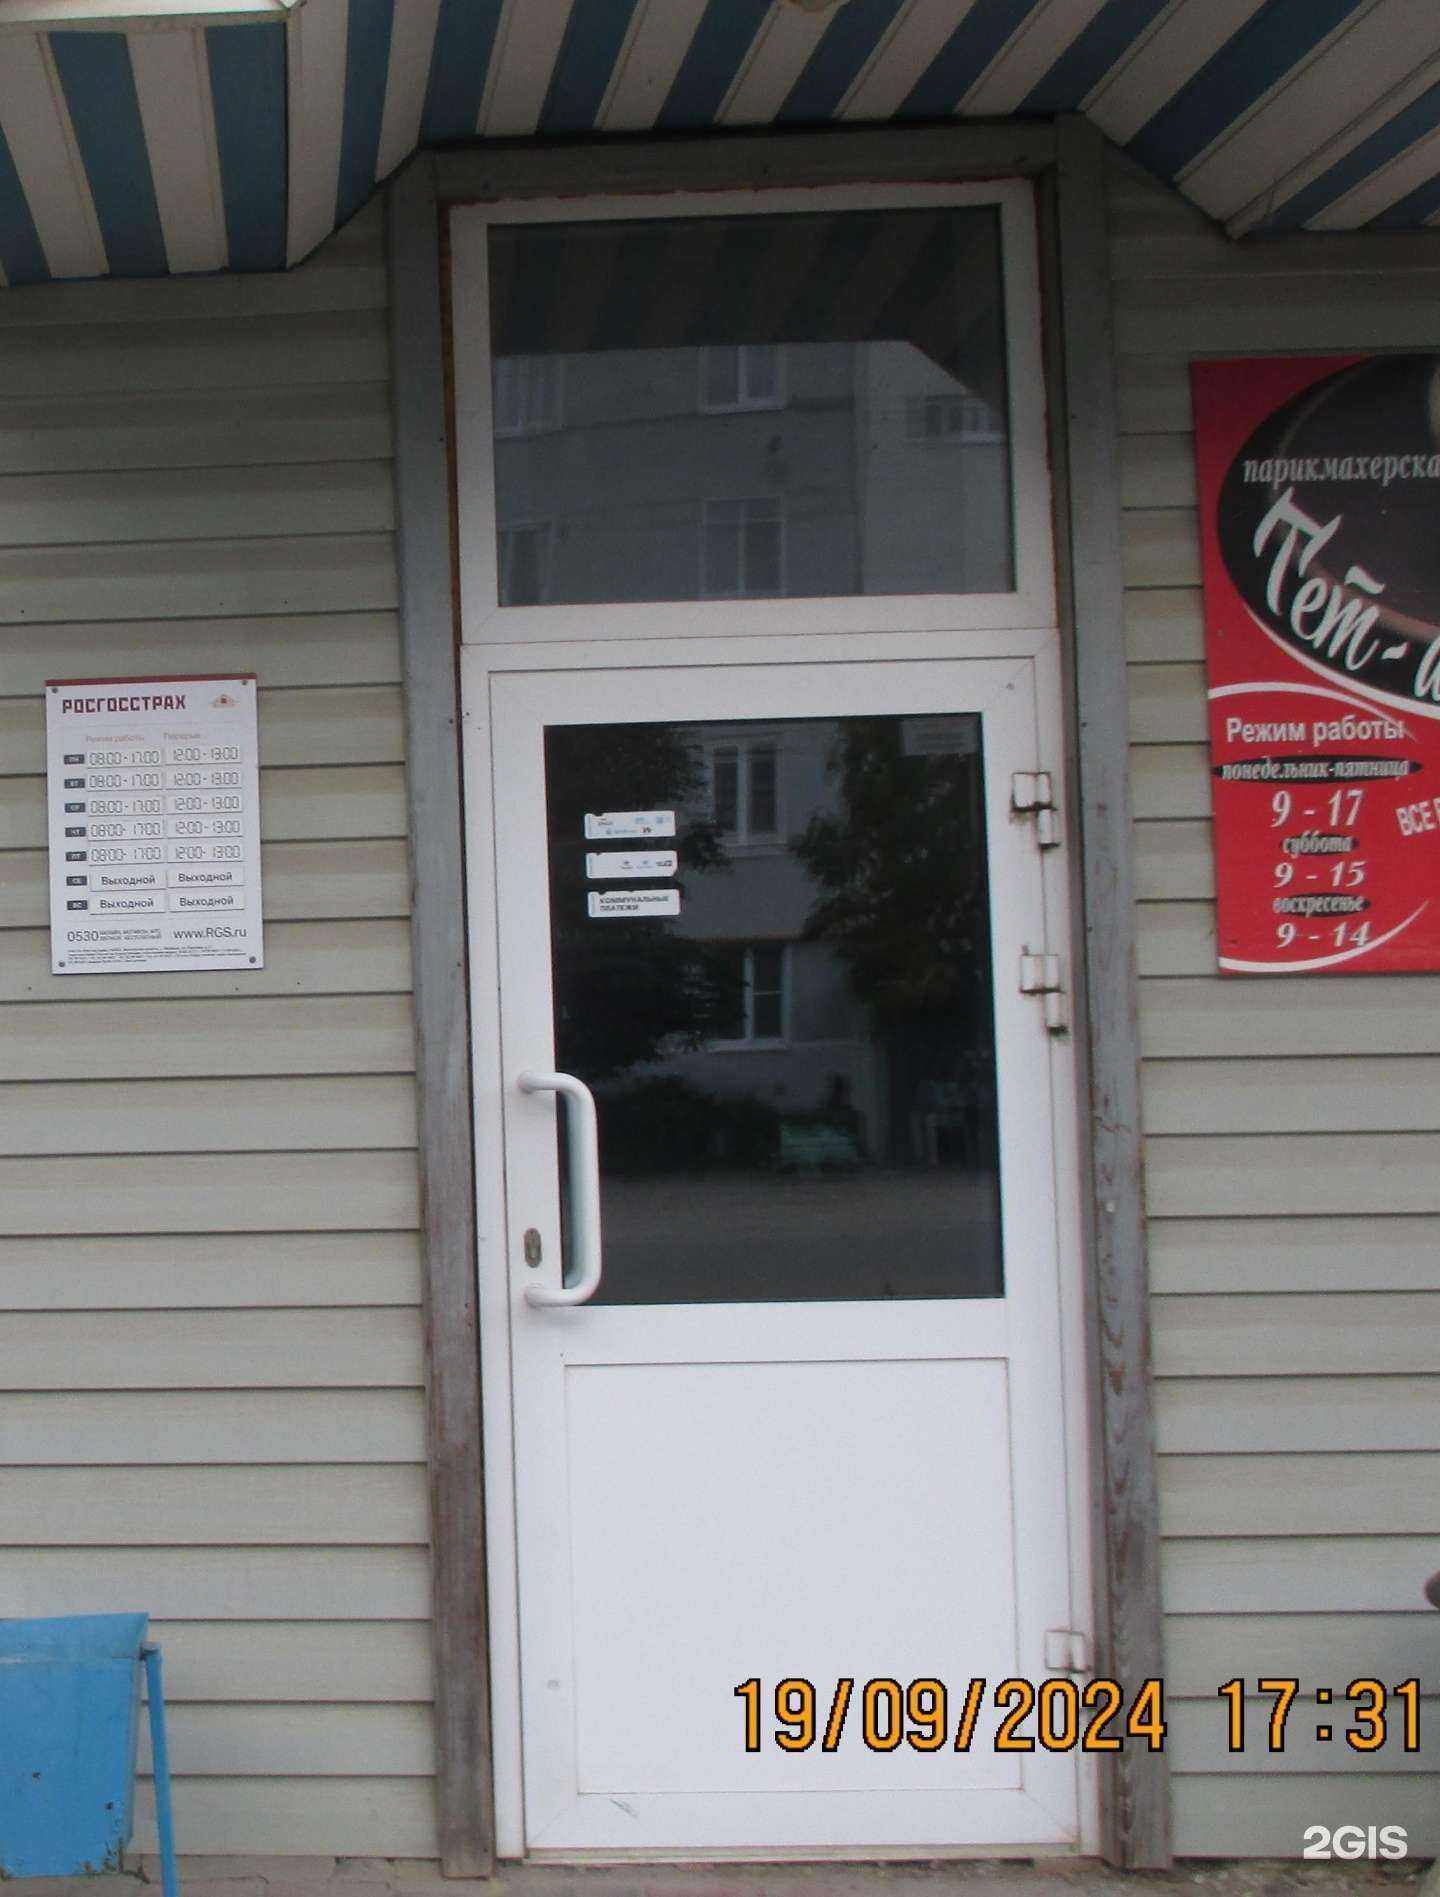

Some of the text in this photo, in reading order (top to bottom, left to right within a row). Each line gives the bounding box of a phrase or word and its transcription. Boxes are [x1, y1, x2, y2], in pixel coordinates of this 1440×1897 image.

[62, 695, 186, 713] РОСГОССТРАХ
[1226, 715, 1405, 746] Режим работы
[1271, 790, 1291, 827] 9
[1328, 790, 1364, 826] 17
[1395, 801, 1435, 836] ВСЕ
[1282, 831, 1352, 858] суббота
[101, 872, 156, 887] Выходной
[178, 869, 233, 883] Выходной
[1274, 862, 1293, 888] 9
[1331, 861, 1366, 887] 15
[99, 895, 154, 909] Выходной
[179, 894, 234, 908] Выходной
[67, 930, 99, 942] 0530
[173, 926, 247, 939] www.RGS.ru
[1277, 922, 1296, 949] 9
[1333, 921, 1372, 948] 14
